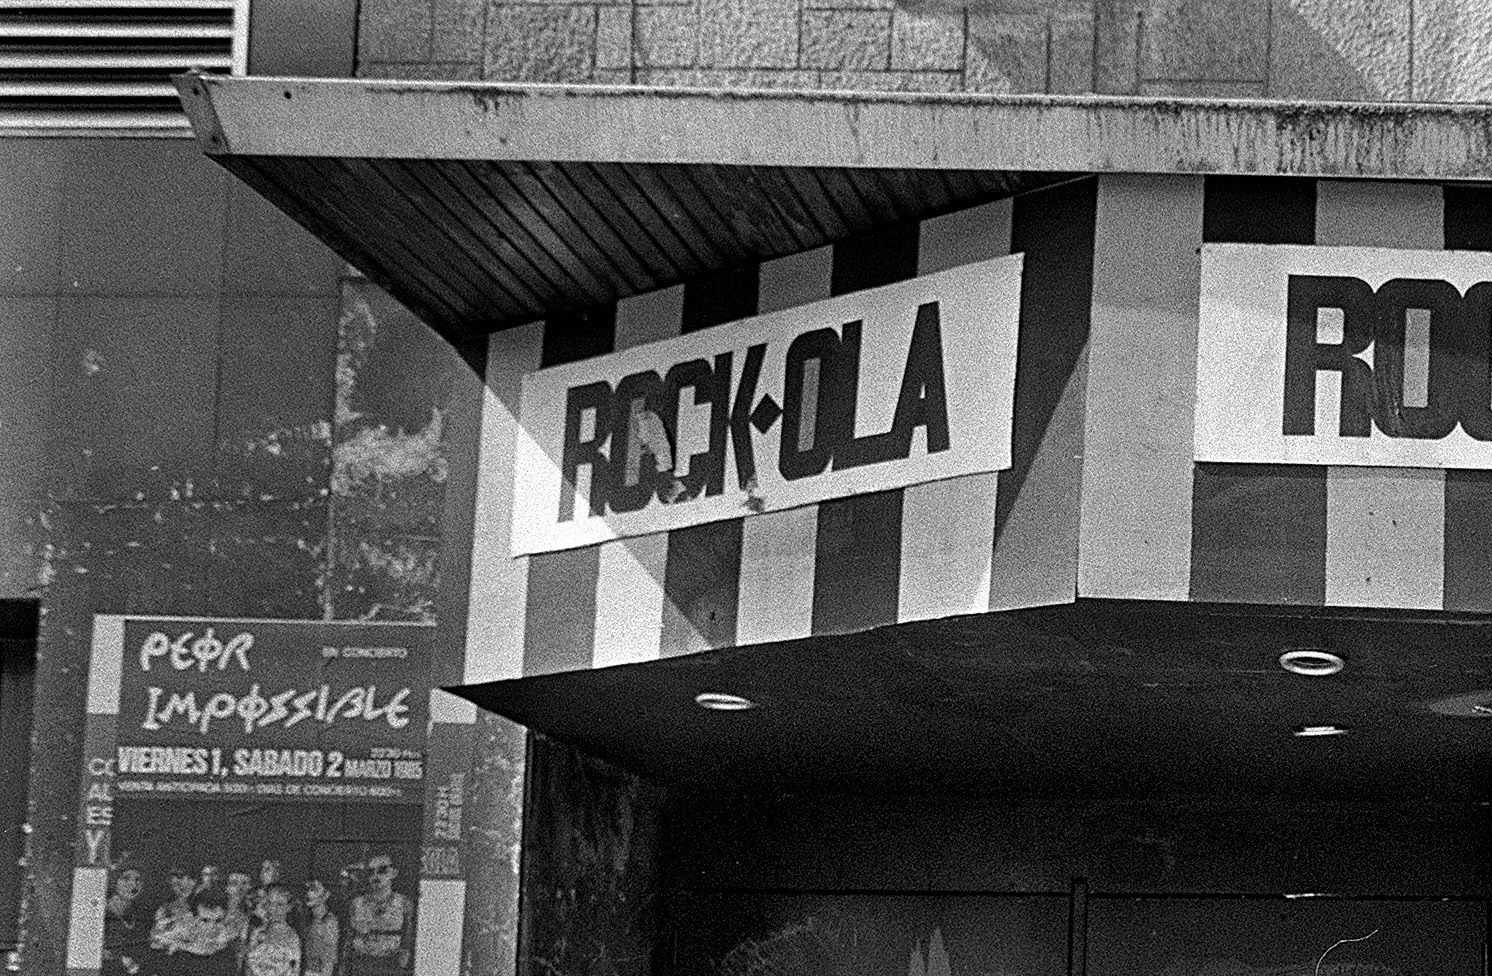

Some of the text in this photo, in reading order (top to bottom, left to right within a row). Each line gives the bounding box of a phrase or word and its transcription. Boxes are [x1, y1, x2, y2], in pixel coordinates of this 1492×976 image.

[118, 747, 208, 774] VIERNES
[233, 749, 323, 777] SABADO
[326, 751, 343, 778] 2
[344, 760, 391, 779] MARZO
